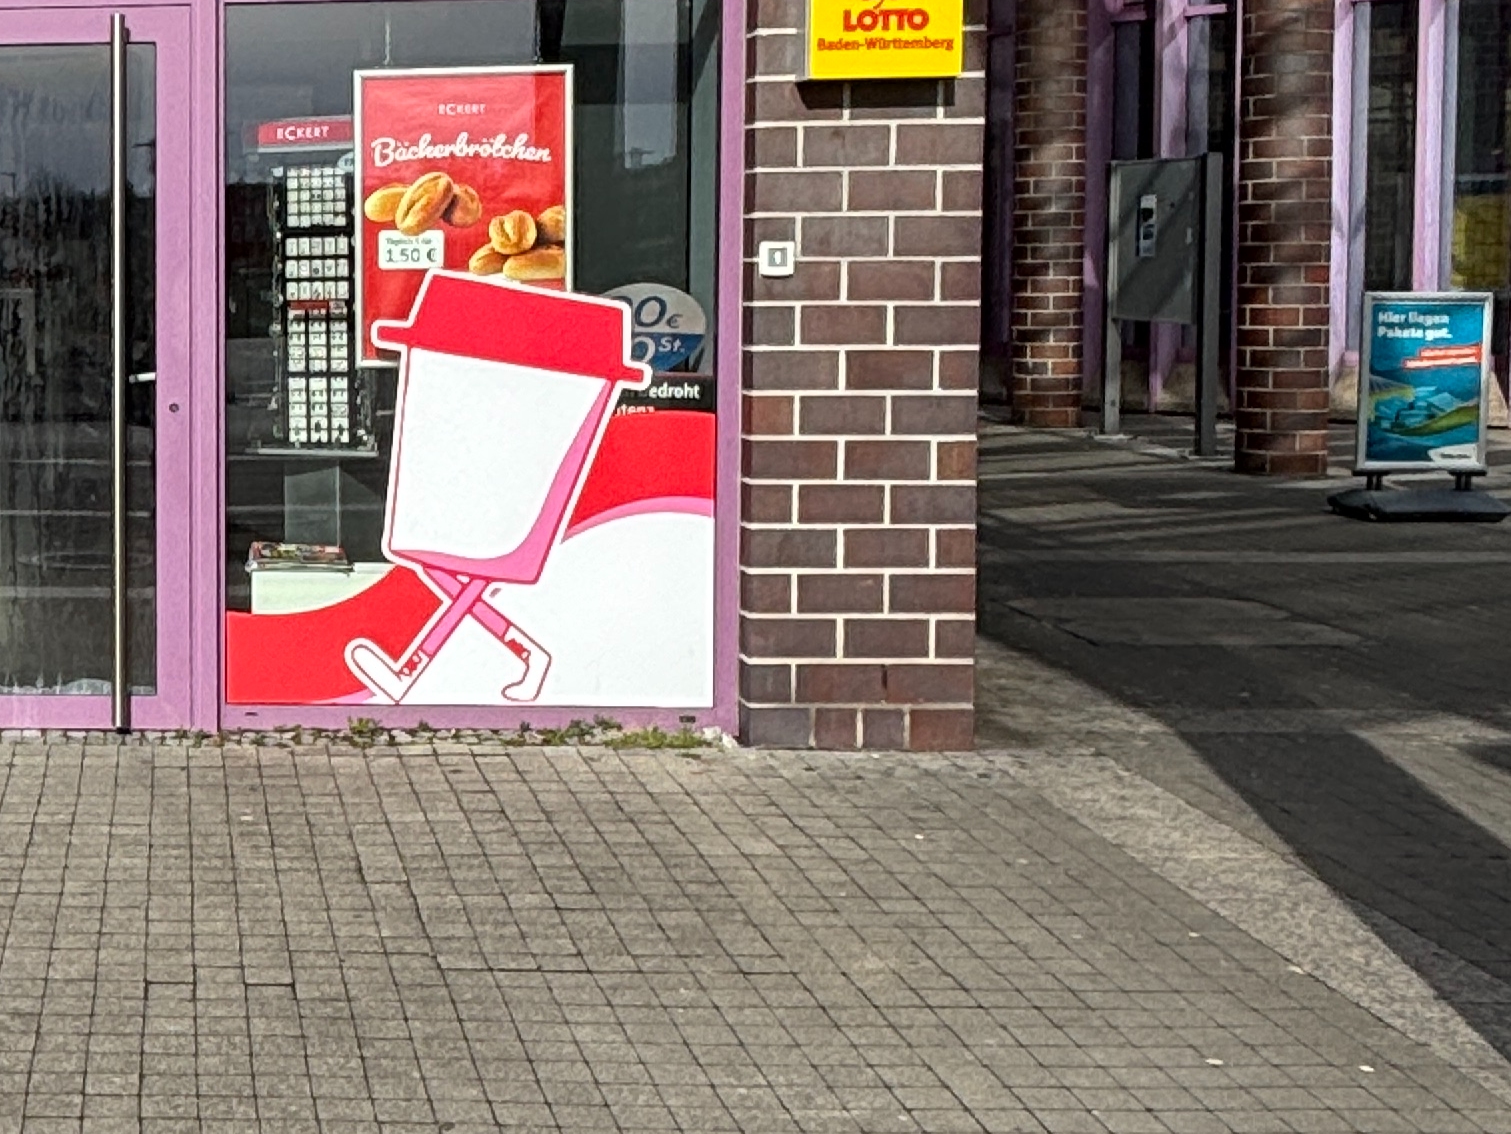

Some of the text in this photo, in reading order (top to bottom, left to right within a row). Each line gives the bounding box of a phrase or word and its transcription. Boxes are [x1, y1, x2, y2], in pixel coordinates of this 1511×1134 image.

[842, 8, 930, 33] LOTTO
[816, 36, 955, 52] Baden-Württemberg
[276, 125, 330, 141] ECKERT
[370, 131, 552, 168] Bäckerbrötchen
[658, 337, 686, 354] St.
[639, 382, 701, 399] edroht
